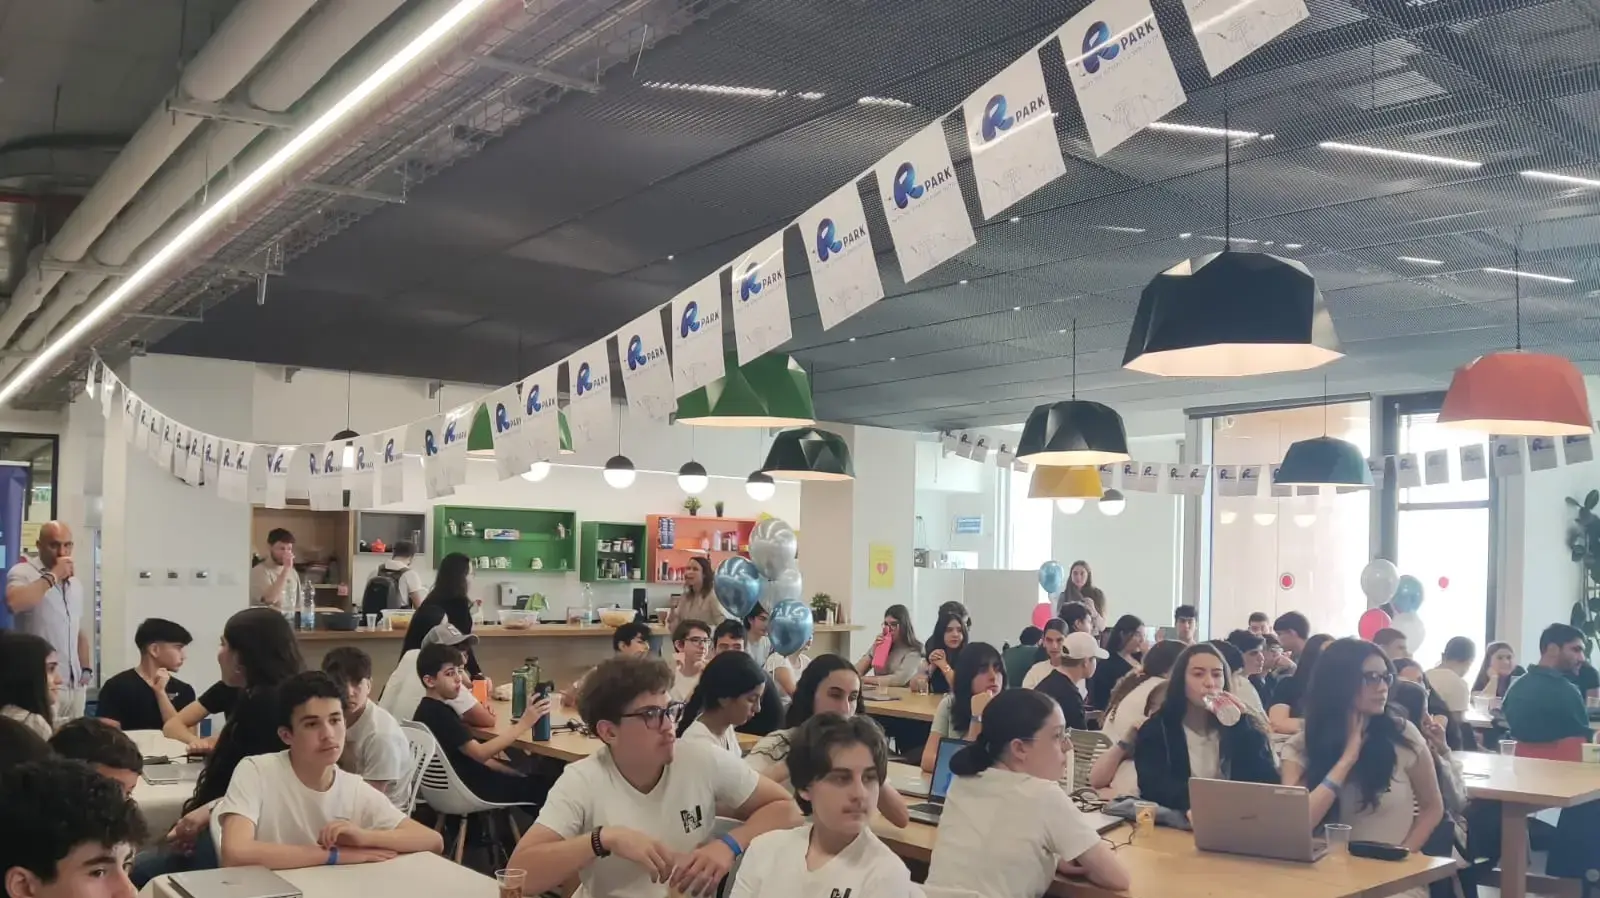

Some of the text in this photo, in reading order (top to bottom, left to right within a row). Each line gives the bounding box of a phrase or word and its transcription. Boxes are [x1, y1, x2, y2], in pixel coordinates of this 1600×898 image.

[1082, 20, 1120, 74] R
[1120, 20, 1155, 50] PARK
[982, 94, 1046, 142] R PARK
[893, 161, 924, 209] R
[924, 167, 952, 191] PARK
[816, 218, 842, 262] R
[842, 225, 866, 248] PARK
[740, 262, 783, 302] R PARK
[680, 300, 720, 338] R PARK
[627, 334, 665, 370] R PARK
[576, 362, 608, 396] R PARK
[496, 402, 510, 432] R
[526, 384, 556, 416] R PARK
